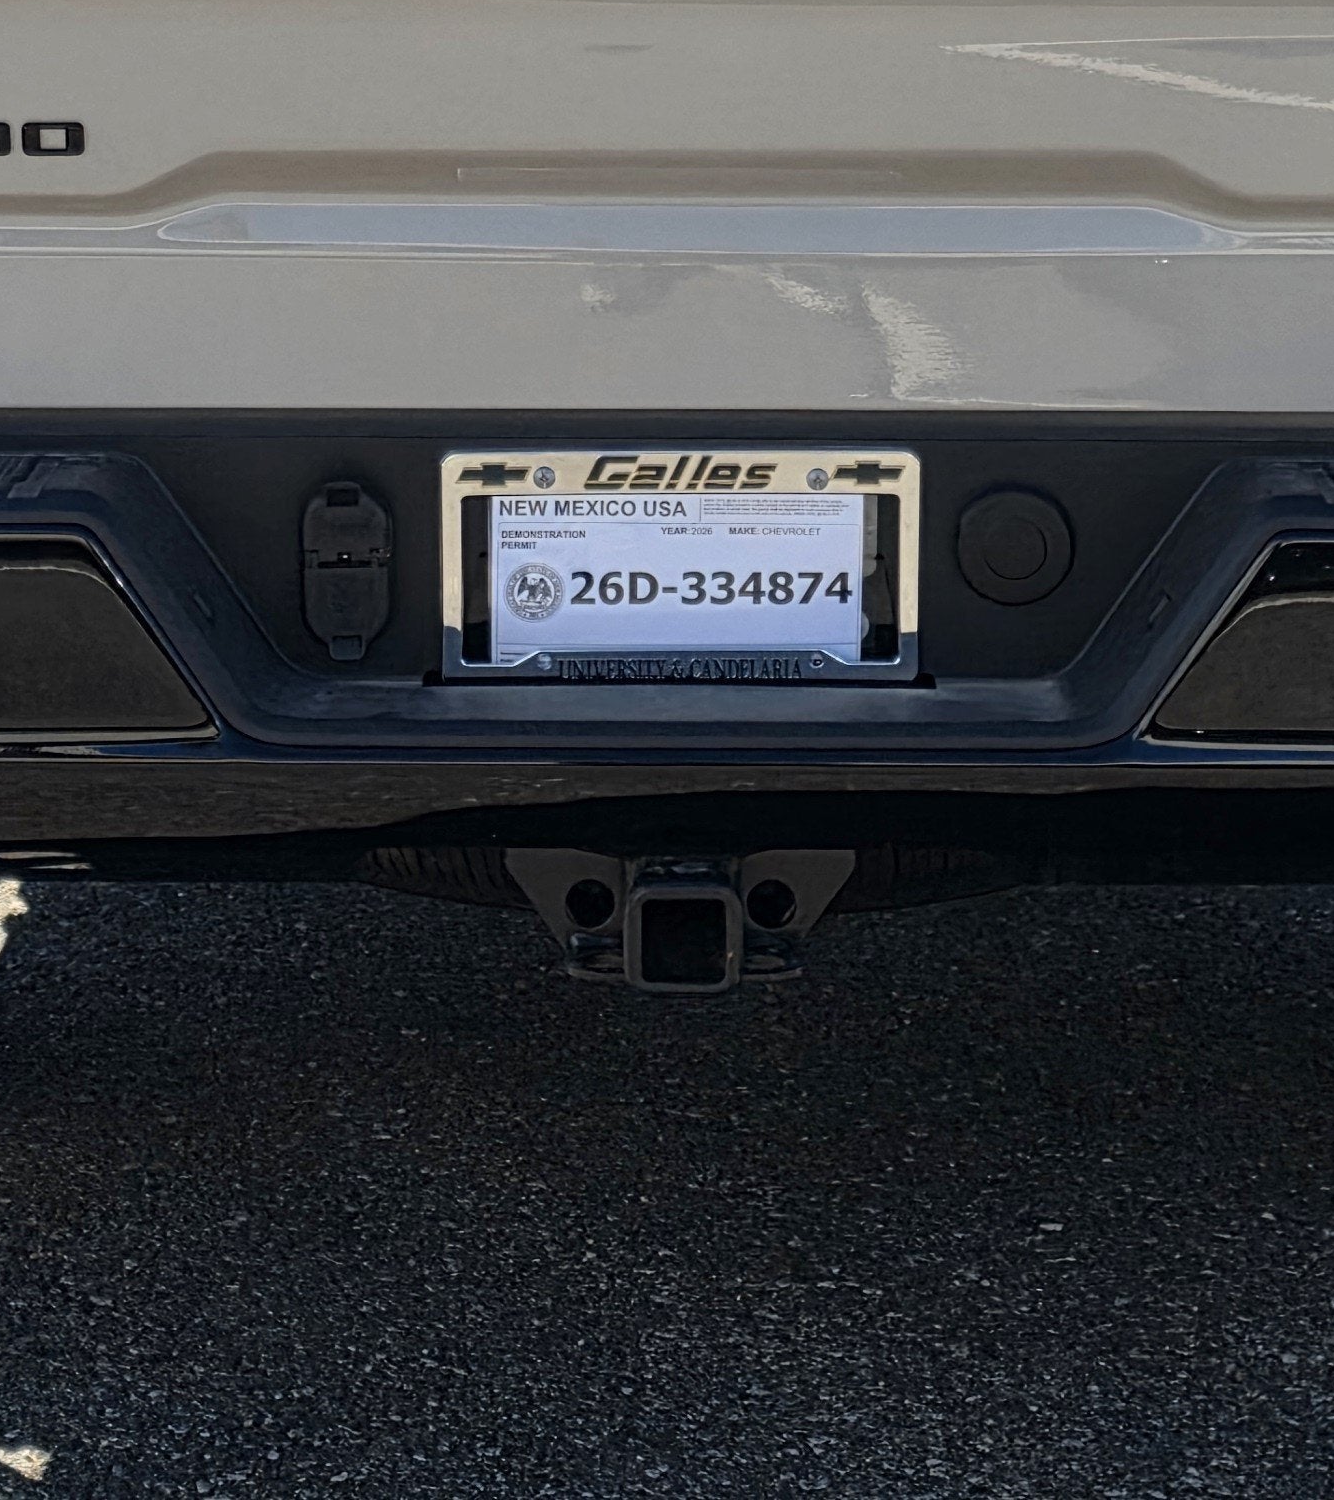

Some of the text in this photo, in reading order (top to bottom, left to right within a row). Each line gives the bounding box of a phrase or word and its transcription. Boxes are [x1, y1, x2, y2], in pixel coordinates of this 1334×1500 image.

[583, 454, 778, 491] Galles
[499, 500, 547, 517] NEW
[554, 500, 637, 517] MEXICO
[643, 500, 688, 518] USA
[500, 530, 587, 539] DEMONSTRATION
[728, 526, 760, 536] MAKE:
[762, 526, 821, 537] CHEVROLET
[500, 541, 538, 550] PERMIT
[570, 570, 853, 605] 26D-334874
[556, 657, 666, 680] UNIVERSITY
[669, 657, 686, 679] &
[689, 657, 803, 680] CANDELARIA
